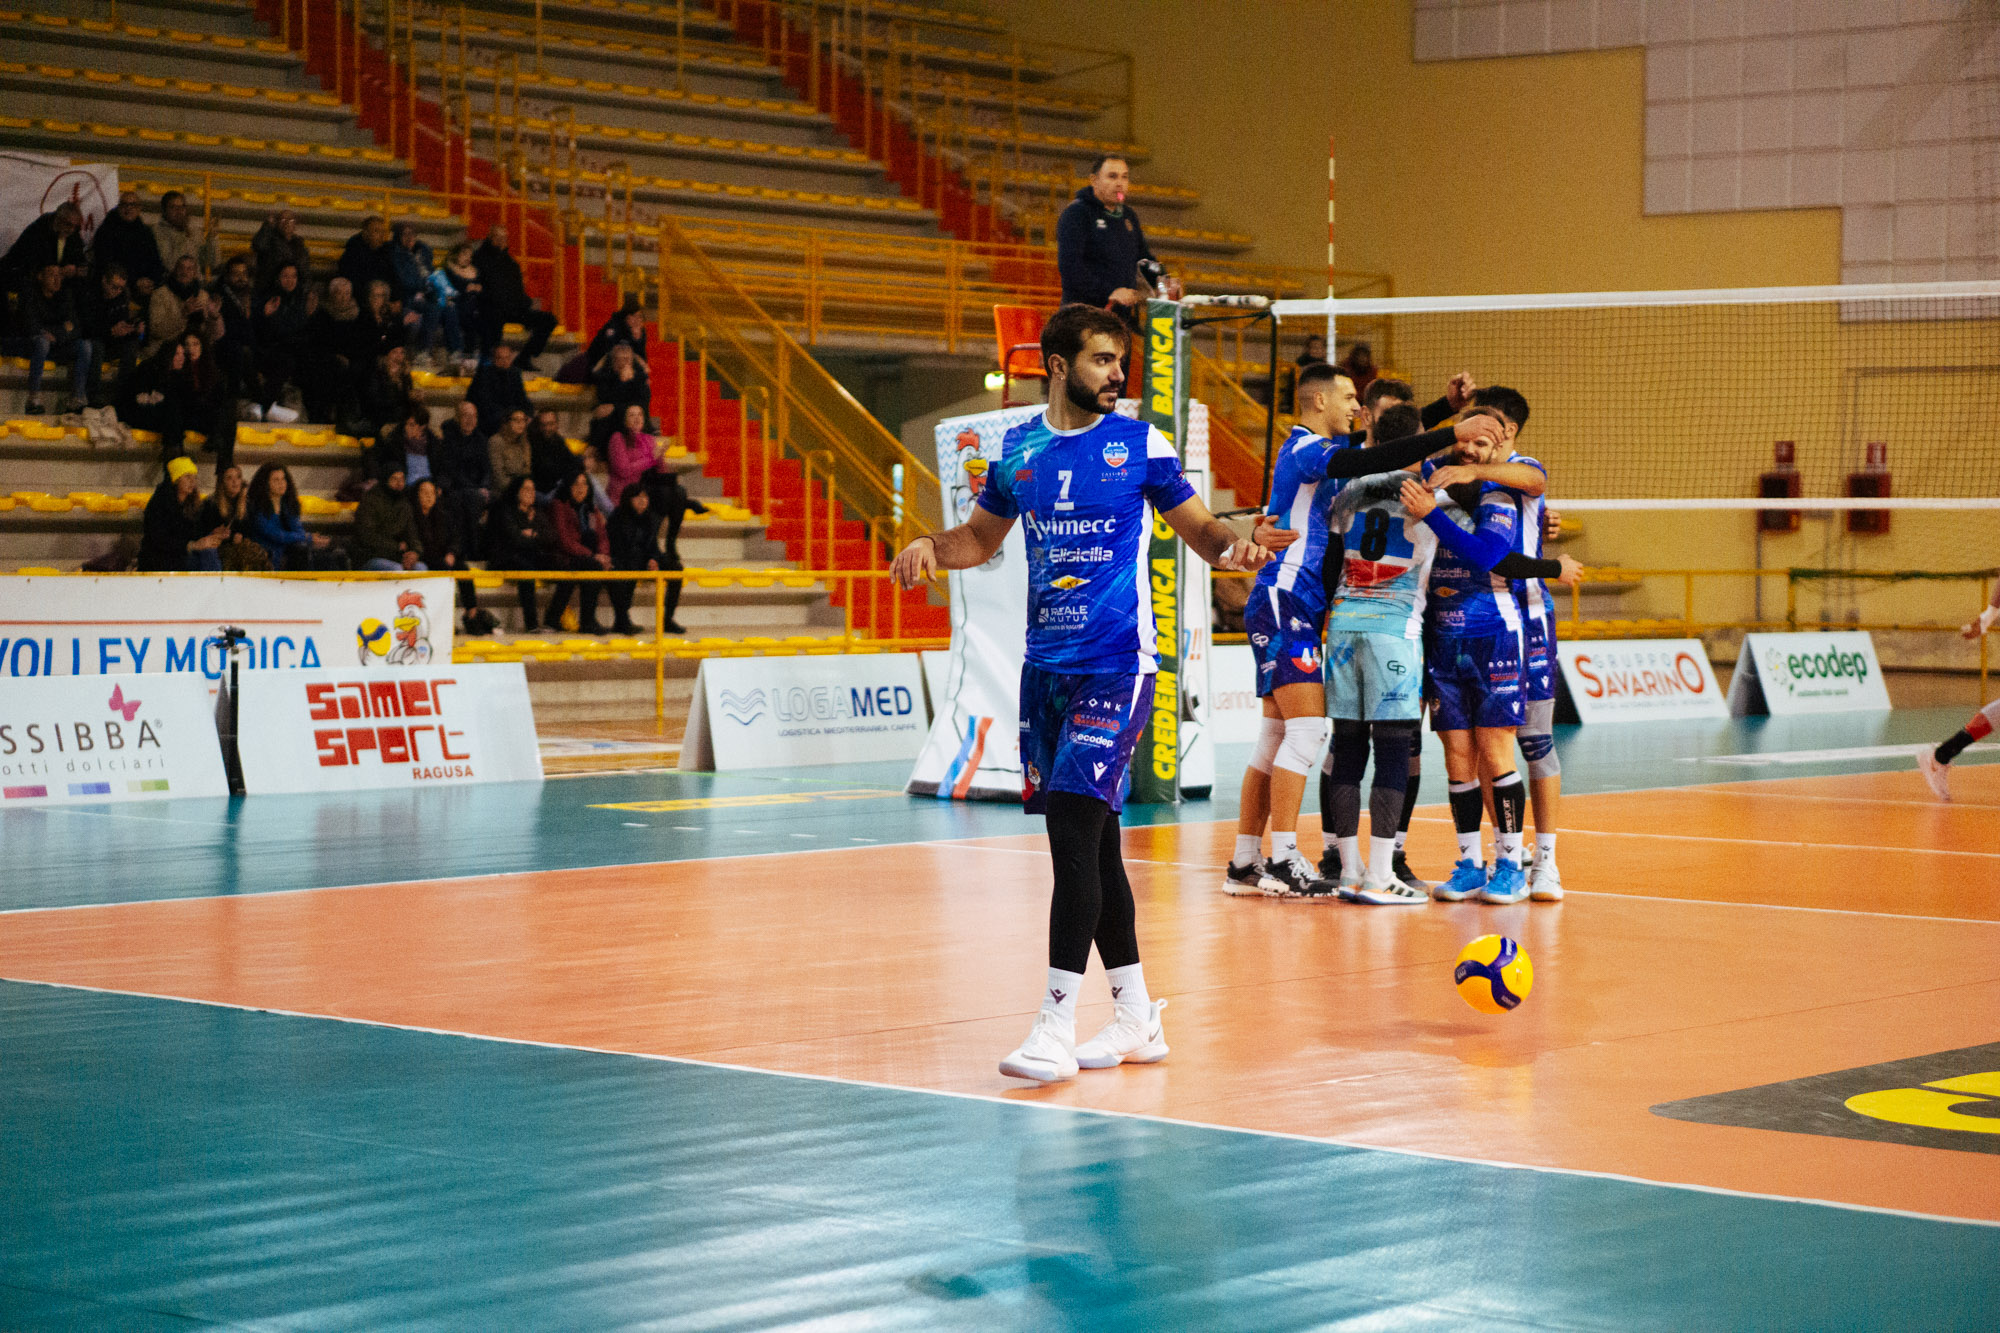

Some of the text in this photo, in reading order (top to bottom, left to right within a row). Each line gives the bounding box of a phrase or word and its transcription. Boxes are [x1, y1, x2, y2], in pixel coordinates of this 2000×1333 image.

[1152, 317, 1174, 416] BANCA
[1058, 470, 1073, 500] 7
[1026, 510, 1117, 541] Avimecc
[1360, 507, 1390, 562] 8
[1051, 605, 1088, 616] REALE
[1152, 558, 1177, 657] BANCA
[1574, 651, 1705, 698] SAVARINO
[1592, 652, 1672, 669] GRUPPO
[1787, 644, 1867, 684] ecodep
[771, 685, 913, 722] LOGAMED
[1080, 697, 1122, 712] ONK
[1077, 733, 1114, 748] ecodep
[1153, 669, 1177, 781] CREDEM
[66, 756, 164, 773] dolciari
[412, 765, 474, 780] RAGUSA
